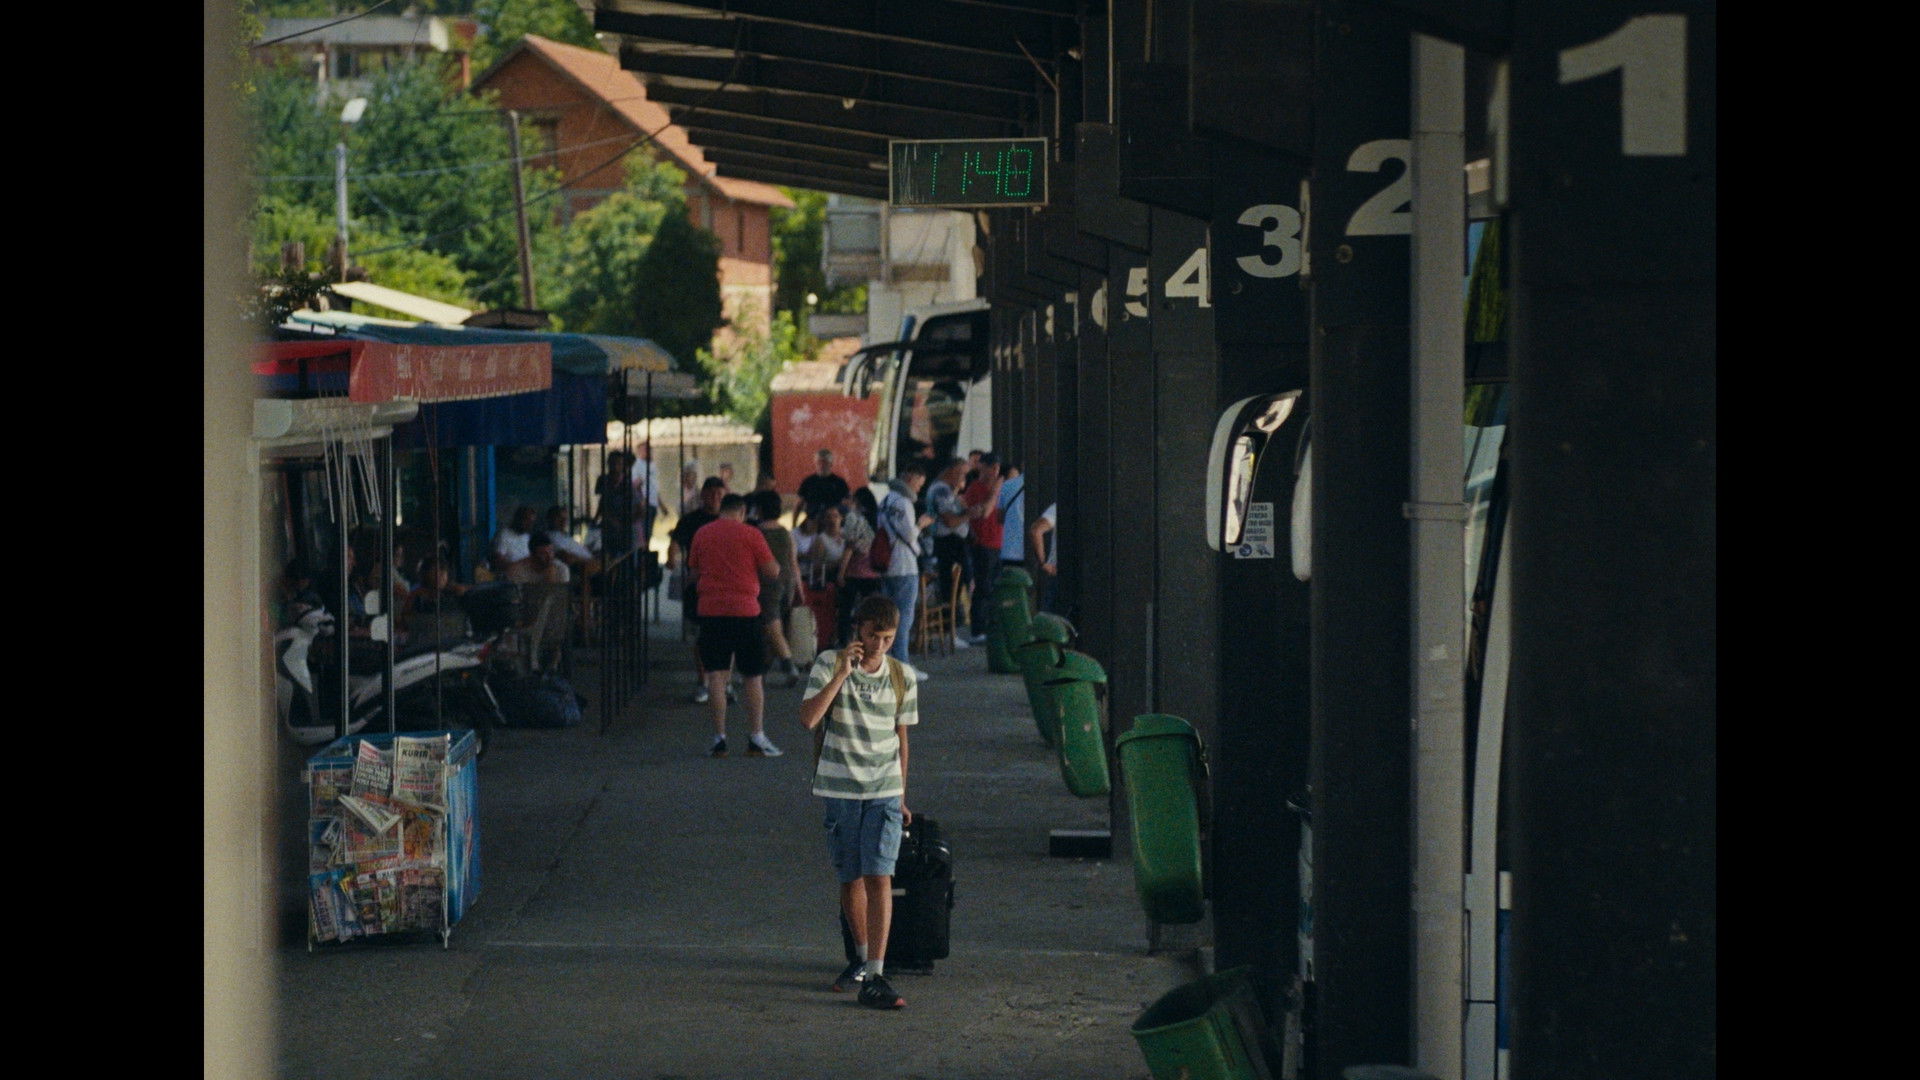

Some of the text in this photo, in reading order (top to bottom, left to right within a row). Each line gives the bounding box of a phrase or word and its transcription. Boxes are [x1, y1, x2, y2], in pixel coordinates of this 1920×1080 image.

[1558, 14, 1688, 156] 1
[930, 147, 1034, 198] 11:48
[1345, 139, 1413, 236] 2
[1236, 204, 1301, 279] 3
[1124, 266, 1148, 318] 5
[1164, 247, 1211, 308] 4
